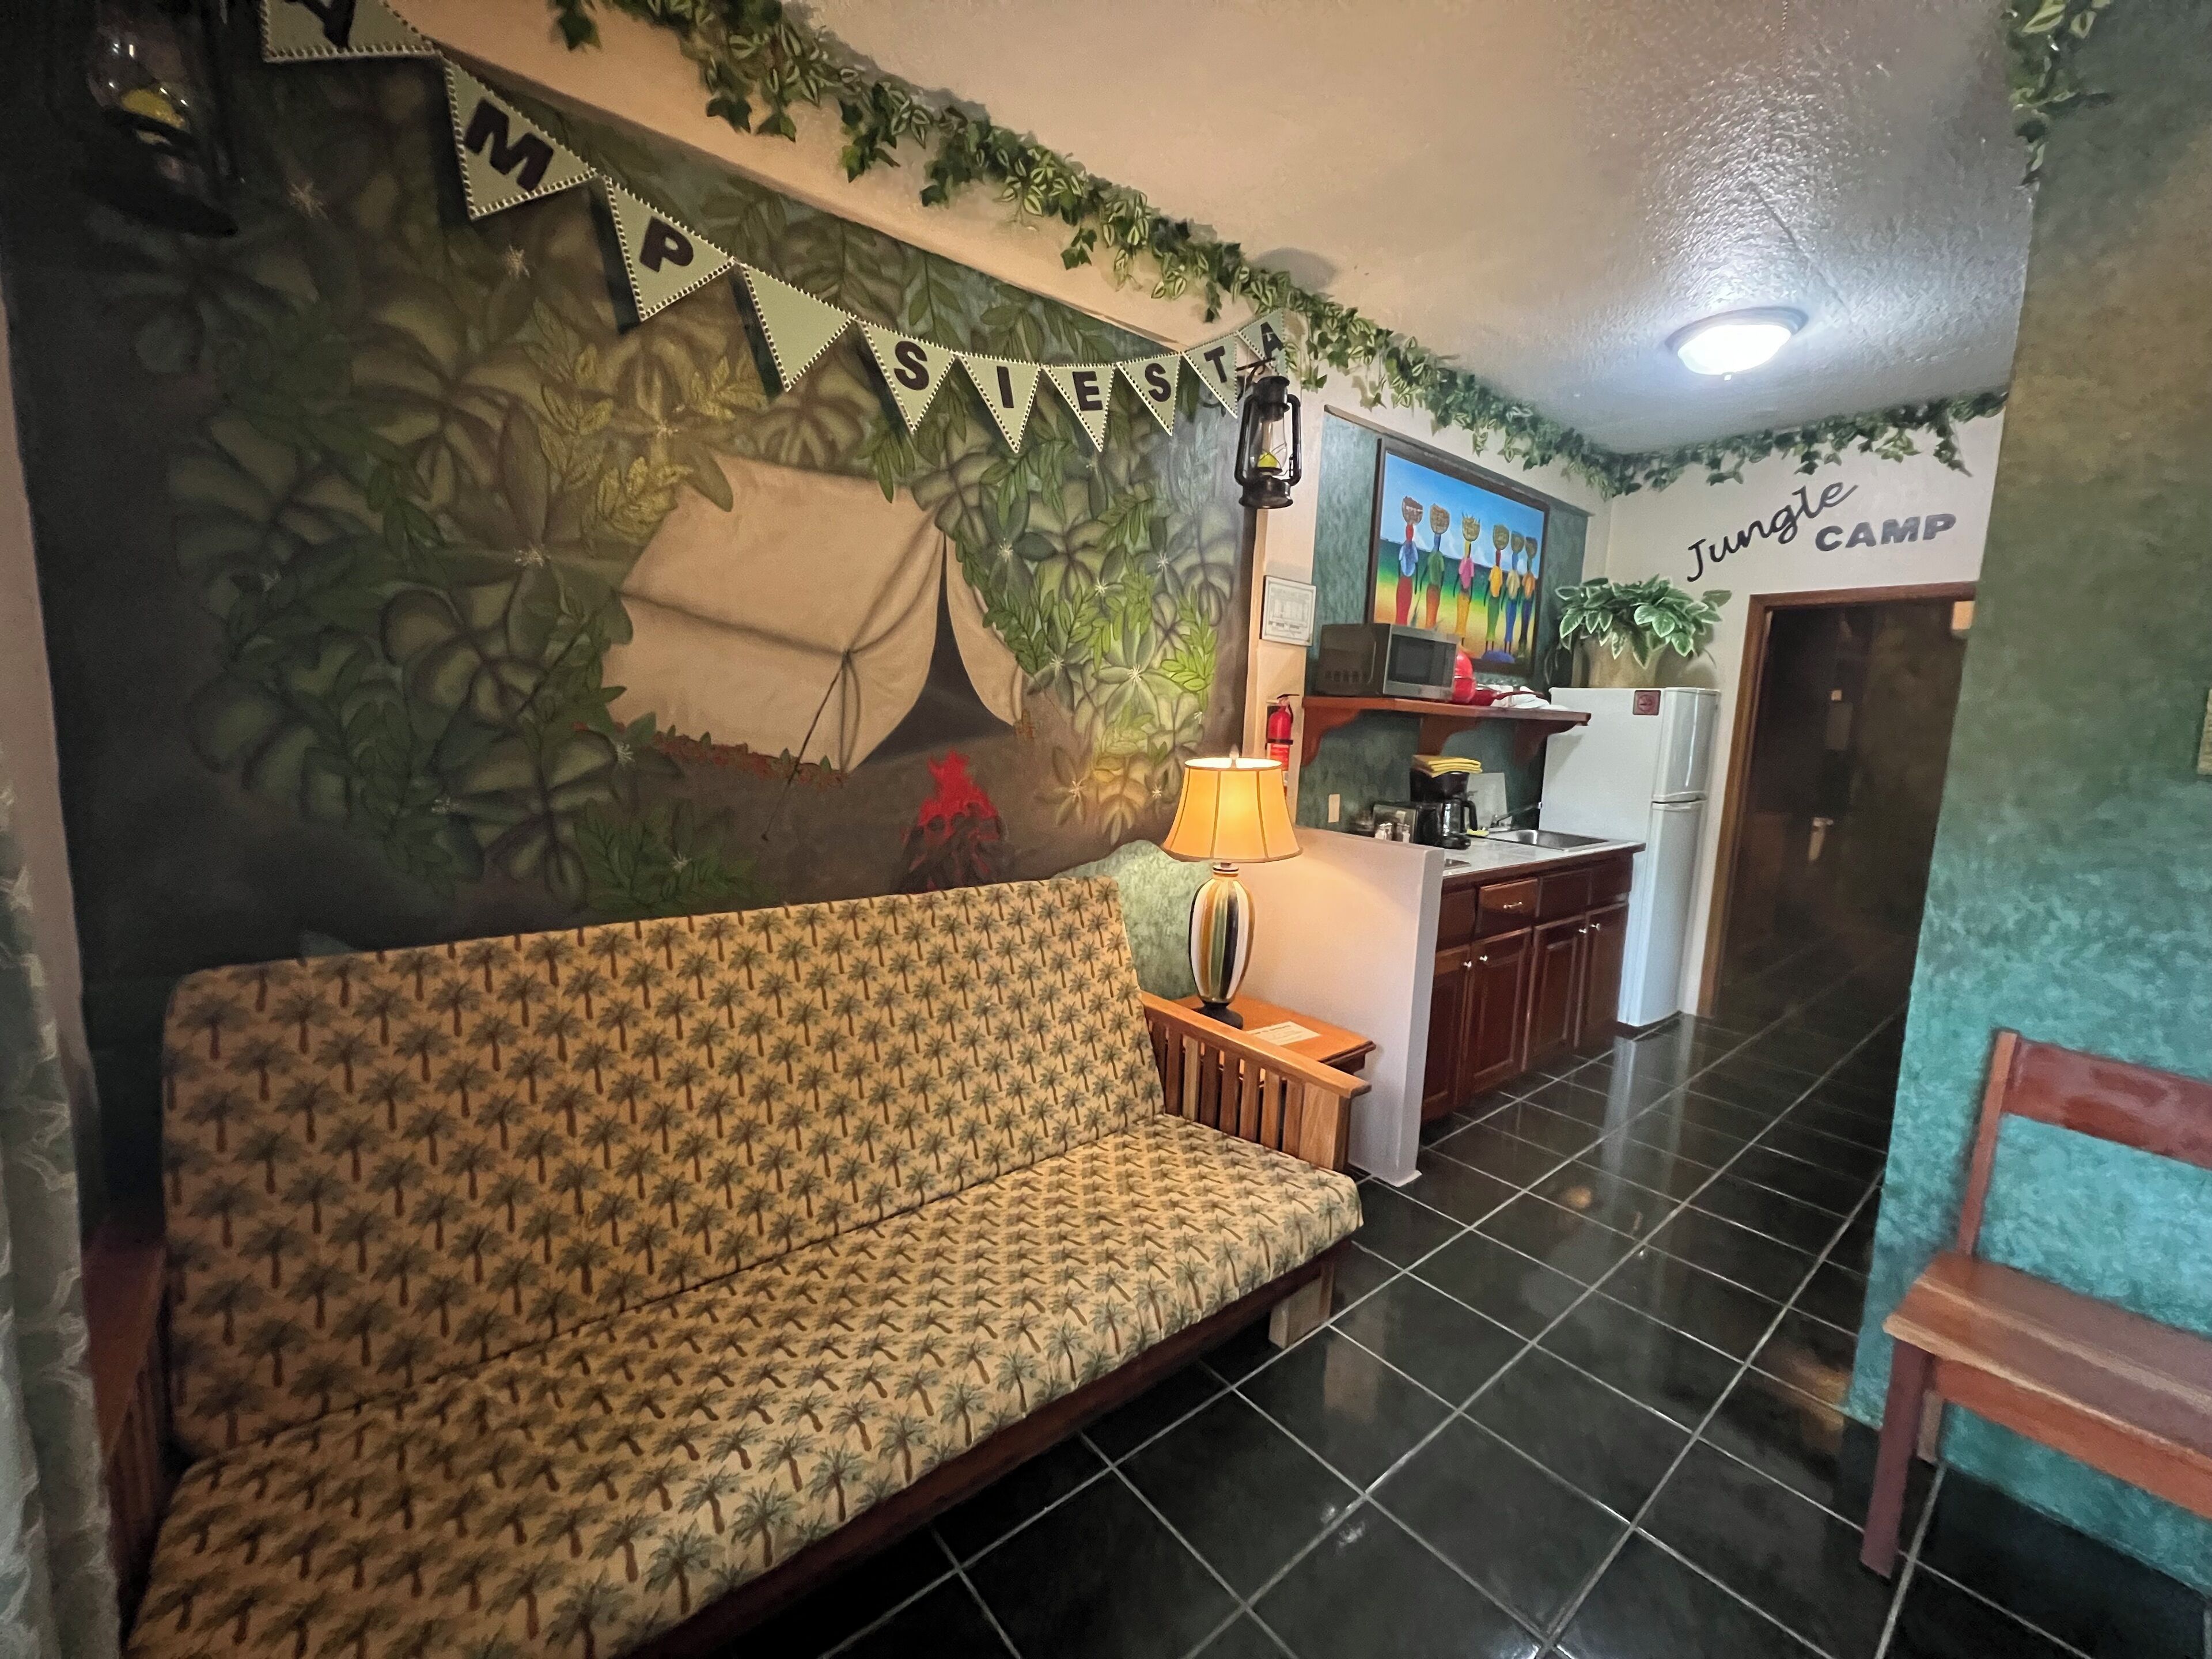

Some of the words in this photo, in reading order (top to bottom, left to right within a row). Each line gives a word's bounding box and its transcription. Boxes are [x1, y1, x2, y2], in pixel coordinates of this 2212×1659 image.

[893, 321, 1284, 412] SIESTA
[1686, 481, 1859, 583] Jungle
[1815, 513, 1957, 552] CAMP
